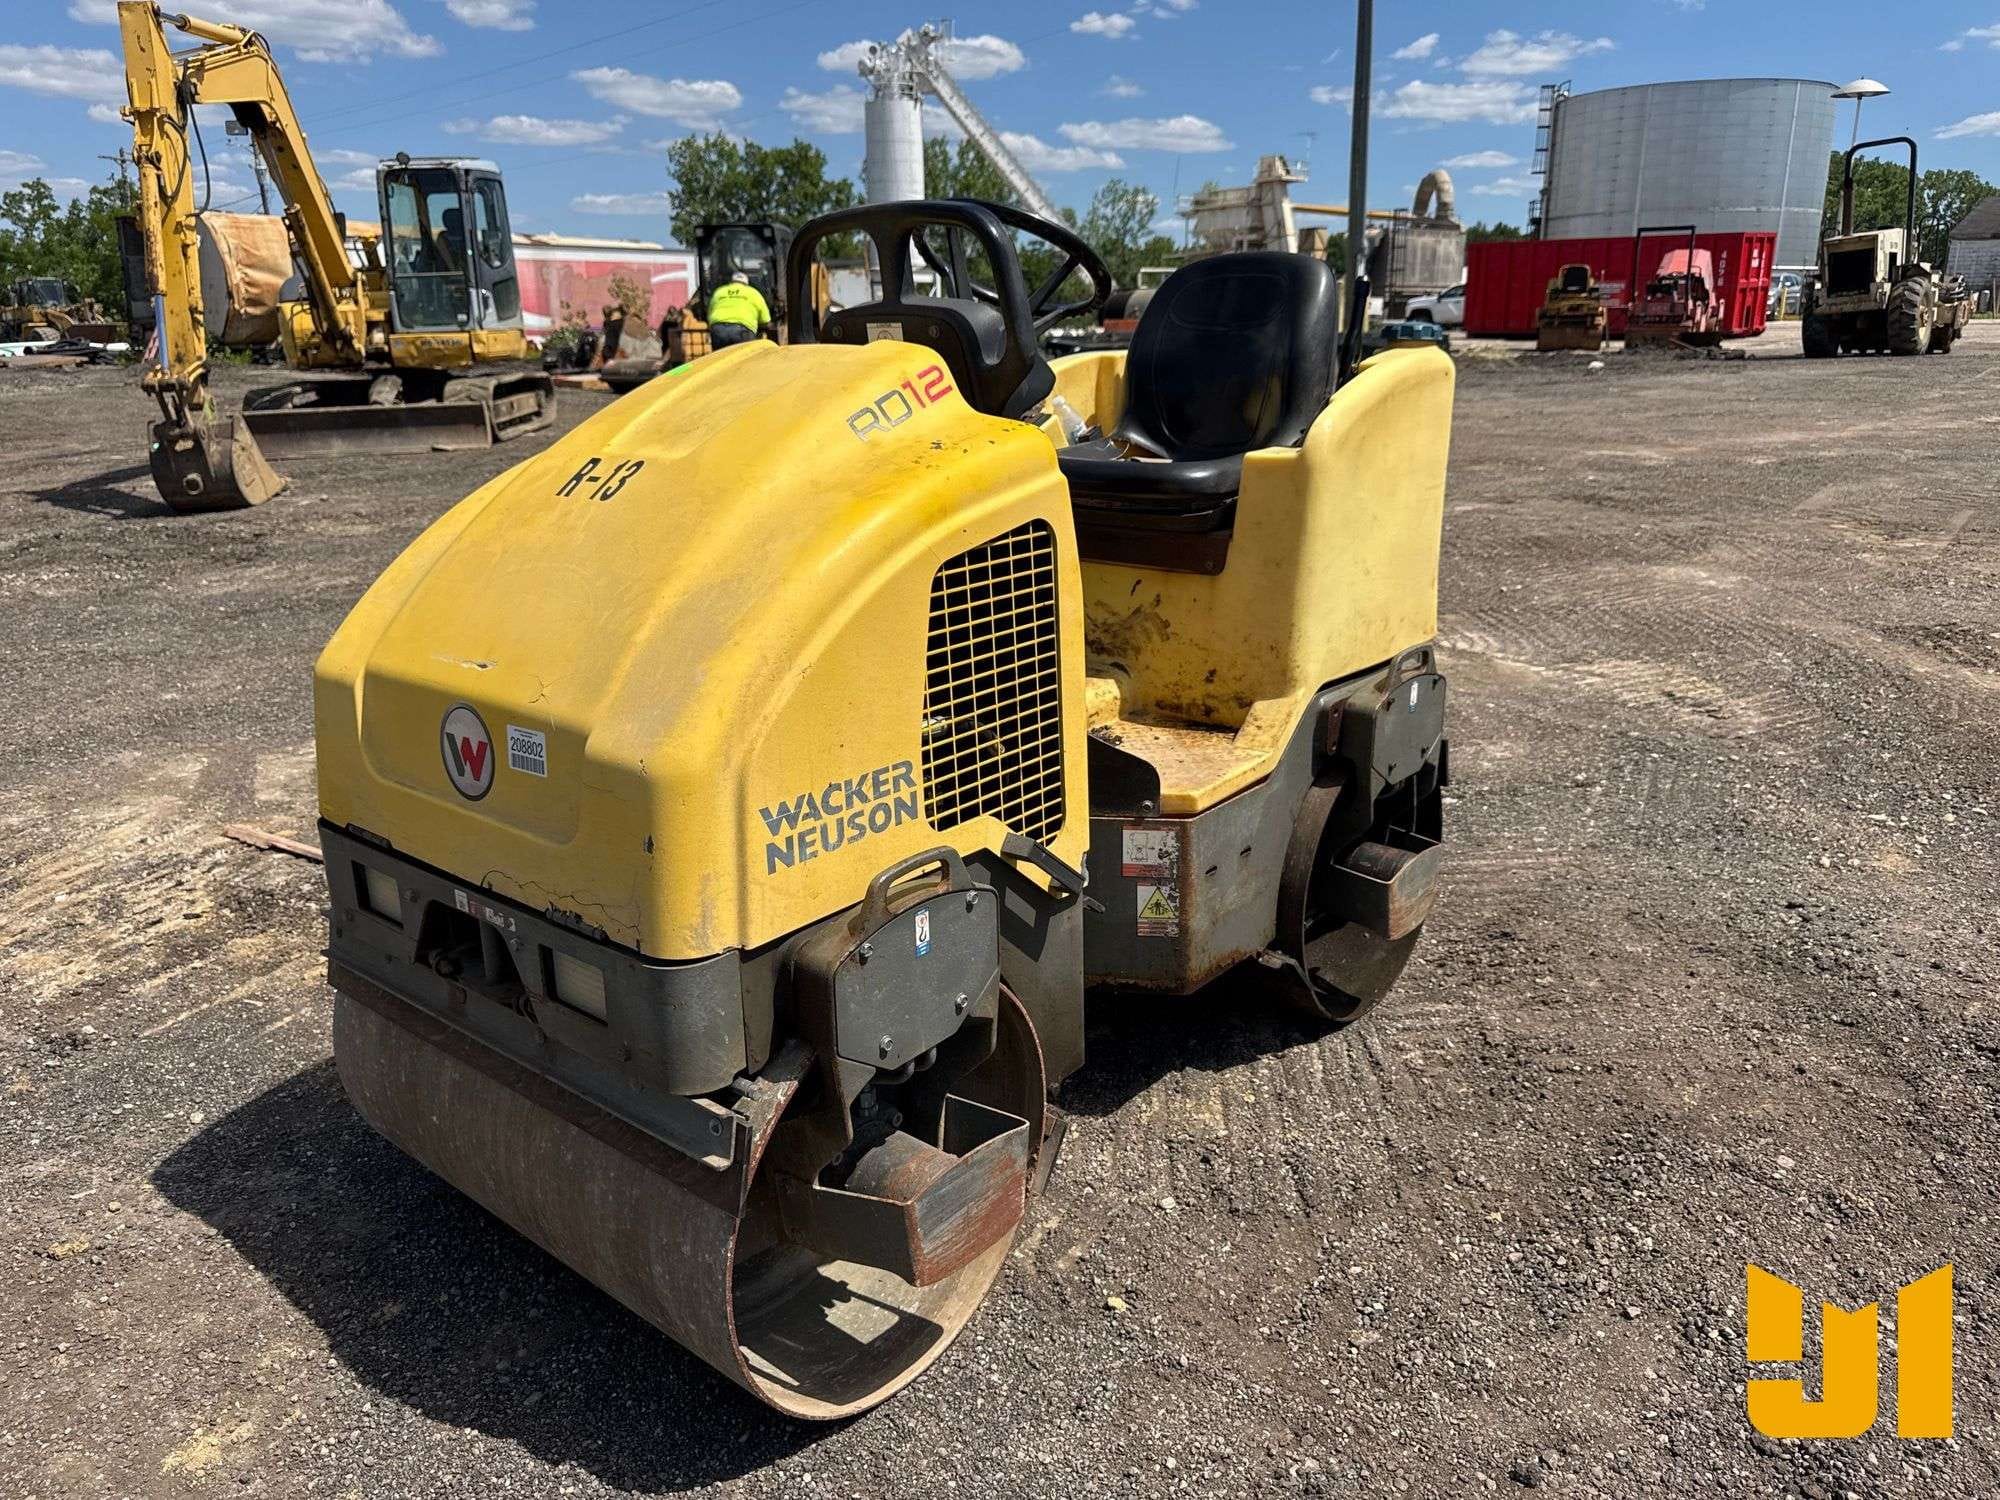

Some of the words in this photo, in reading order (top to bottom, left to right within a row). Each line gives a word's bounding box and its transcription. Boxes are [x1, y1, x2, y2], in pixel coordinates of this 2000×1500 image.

[846, 365, 953, 443] RD12
[556, 457, 645, 501] R-13
[510, 737, 544, 758] 208802
[758, 760, 917, 837] WACKER
[766, 790, 919, 876] NEUSON
